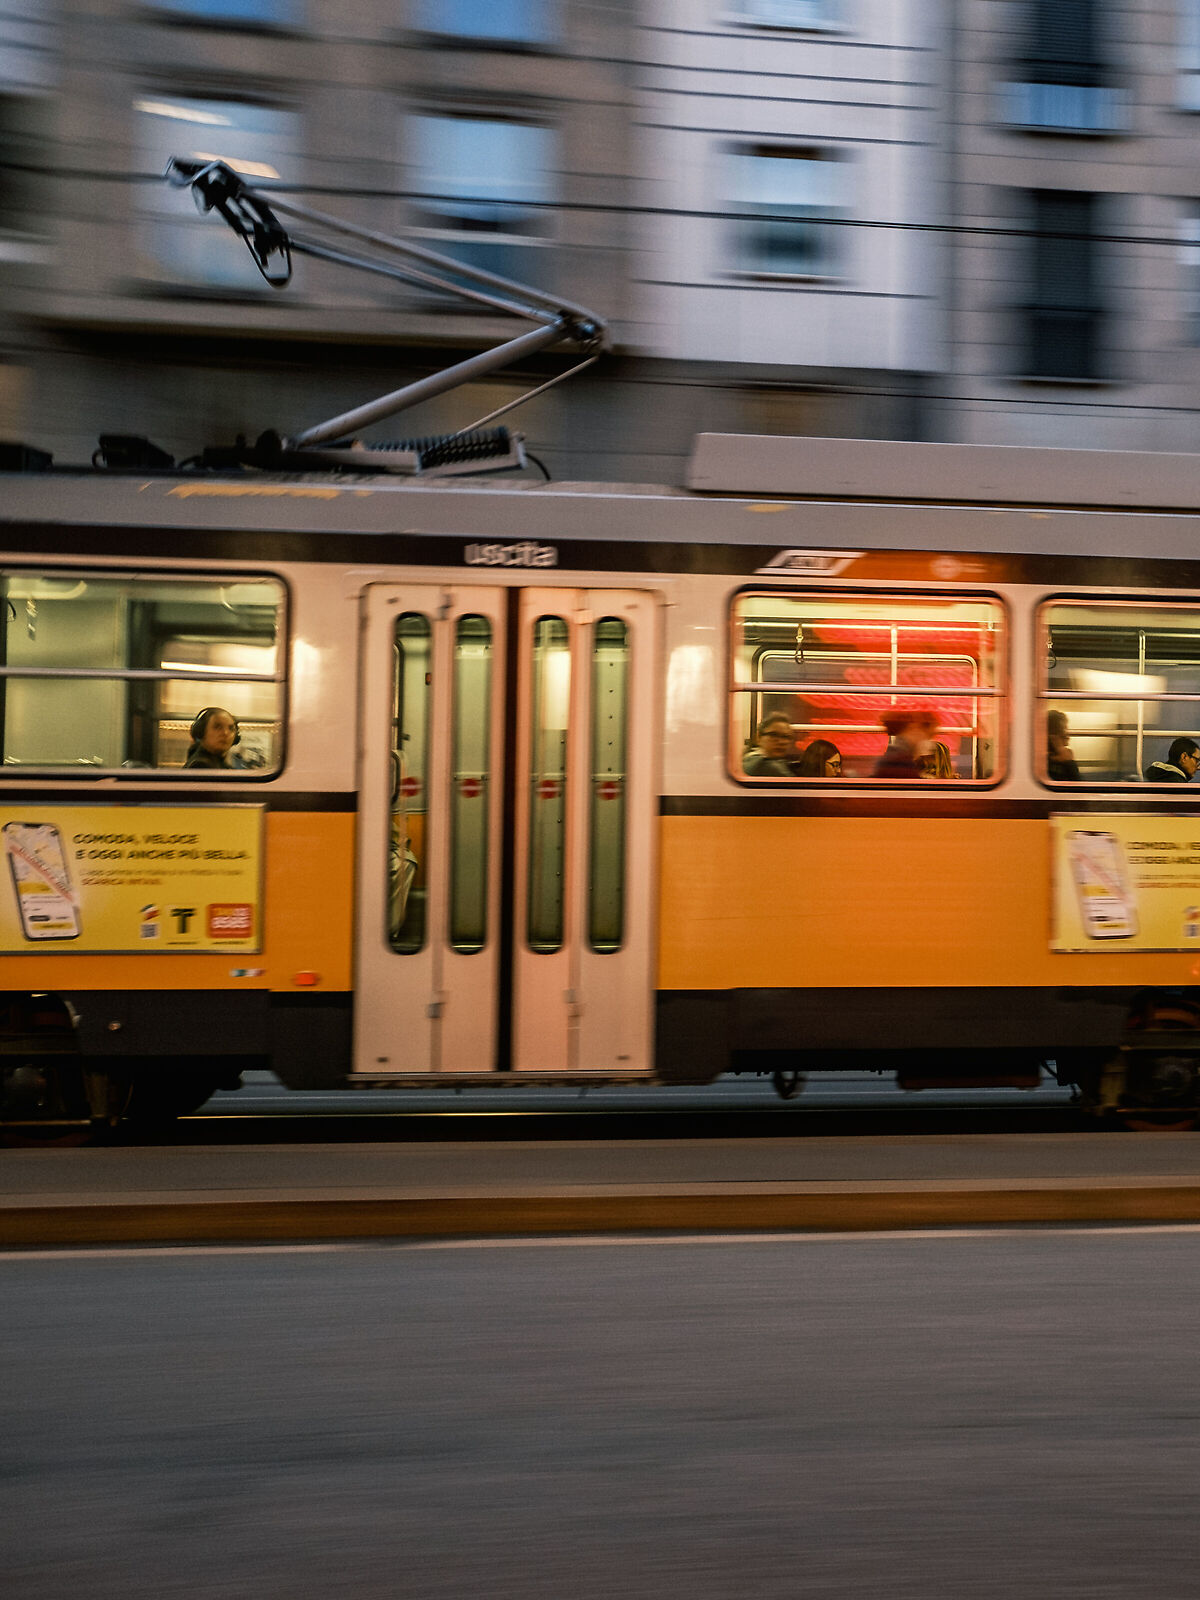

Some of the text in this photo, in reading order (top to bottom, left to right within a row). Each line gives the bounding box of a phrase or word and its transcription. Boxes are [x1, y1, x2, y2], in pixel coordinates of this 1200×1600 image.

[464, 541, 558, 567] uscita
[145, 834, 199, 845] VELOCE
[75, 850, 85, 860] E
[88, 849, 122, 860] OGGI
[127, 850, 176, 860] ANCHE
